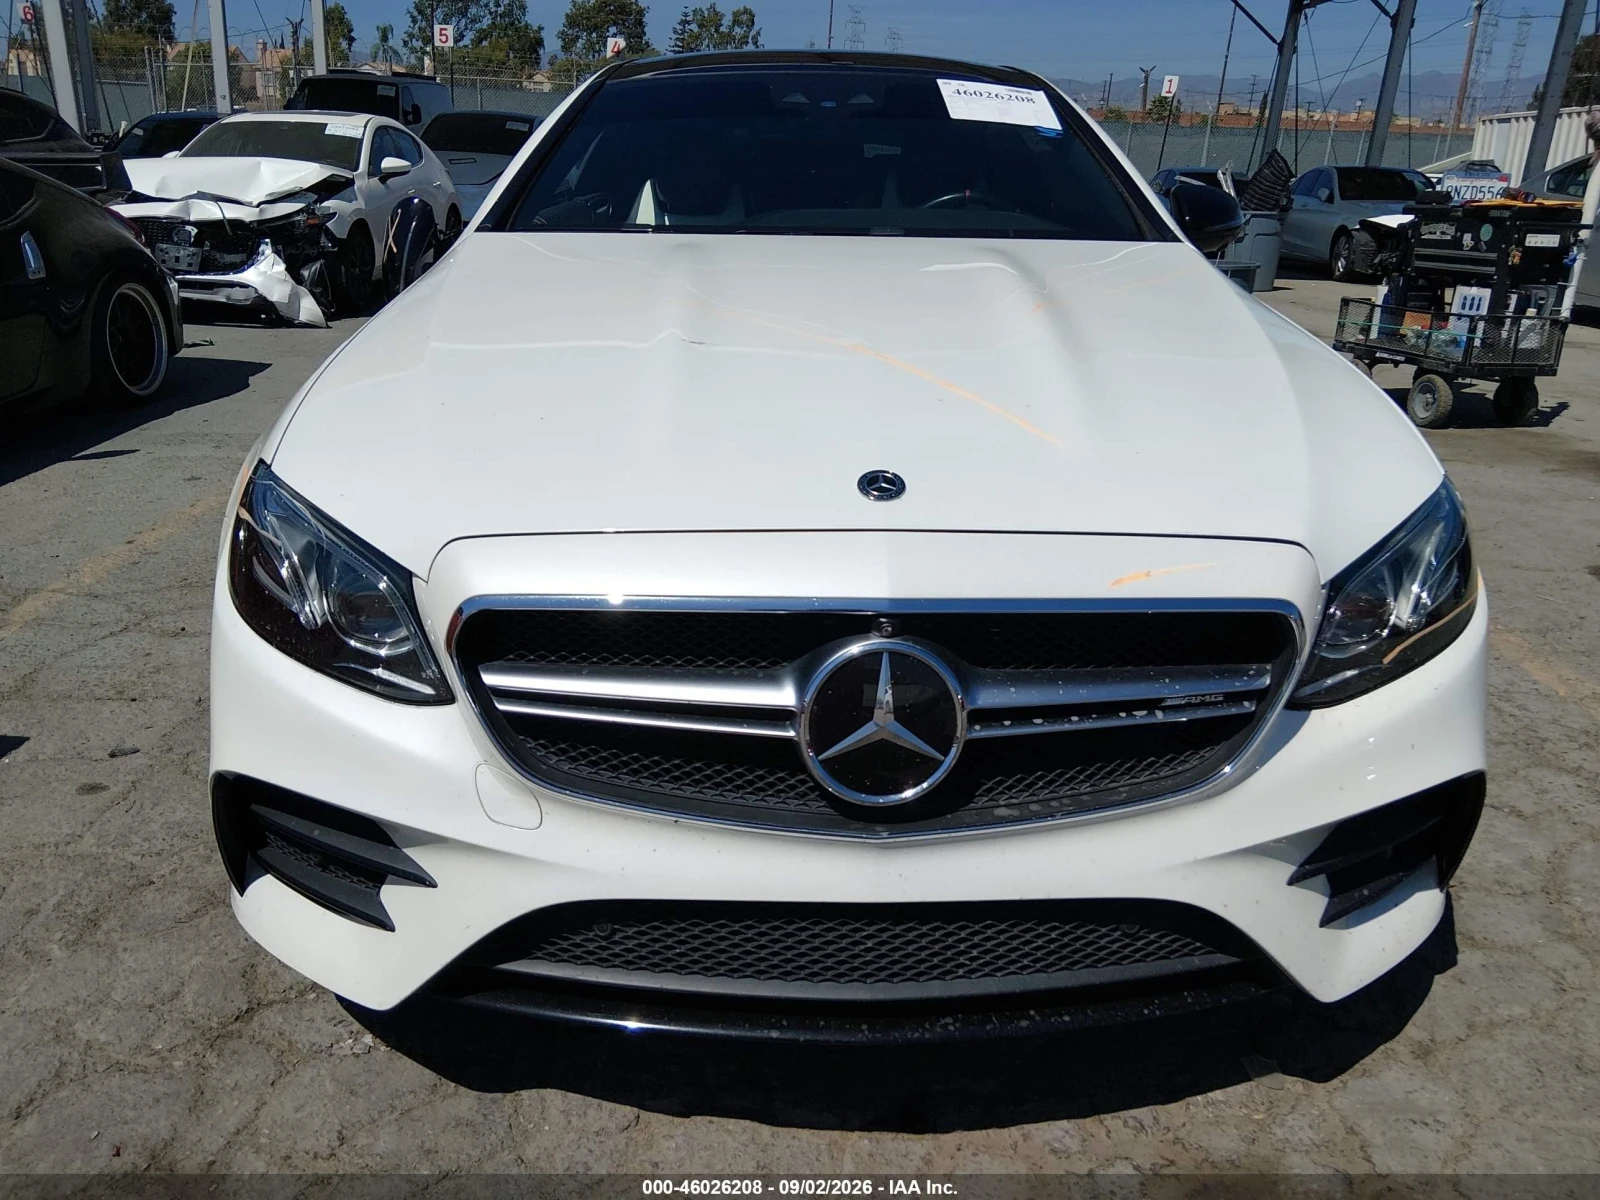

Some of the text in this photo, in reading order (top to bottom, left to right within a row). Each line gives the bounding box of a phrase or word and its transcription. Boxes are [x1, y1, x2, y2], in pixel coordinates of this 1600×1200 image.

[22, 5, 34, 22] 6
[438, 27, 449, 44] 5
[610, 40, 622, 57] 4
[1164, 77, 1174, 94] 1
[952, 88, 1036, 104] 46026208
[1180, 693, 1224, 703] AMG
